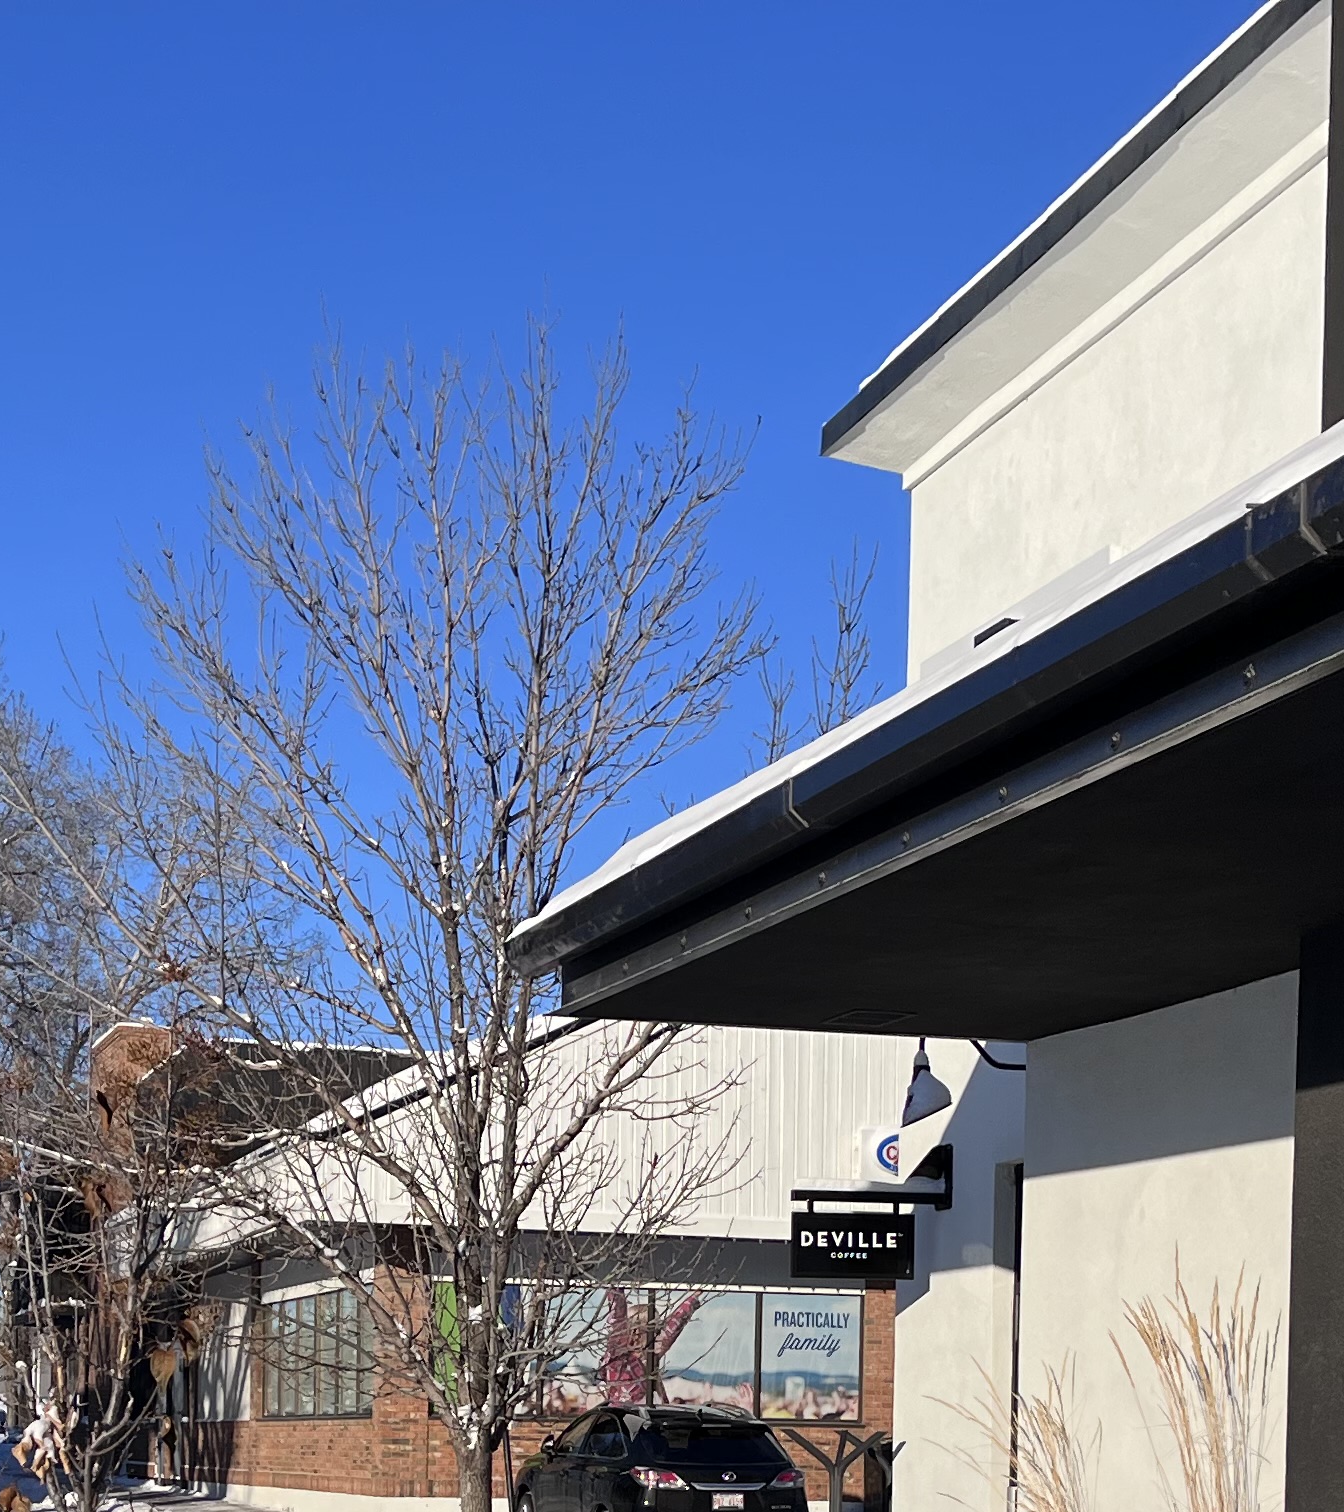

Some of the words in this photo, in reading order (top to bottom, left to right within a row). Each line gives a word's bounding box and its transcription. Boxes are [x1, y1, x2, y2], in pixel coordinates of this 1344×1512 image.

[800, 1231, 898, 1248] DEVILLE
[830, 1252, 868, 1260] COFFEE
[773, 1311, 851, 1329] PRACTICALLY
[776, 1332, 842, 1358] family
